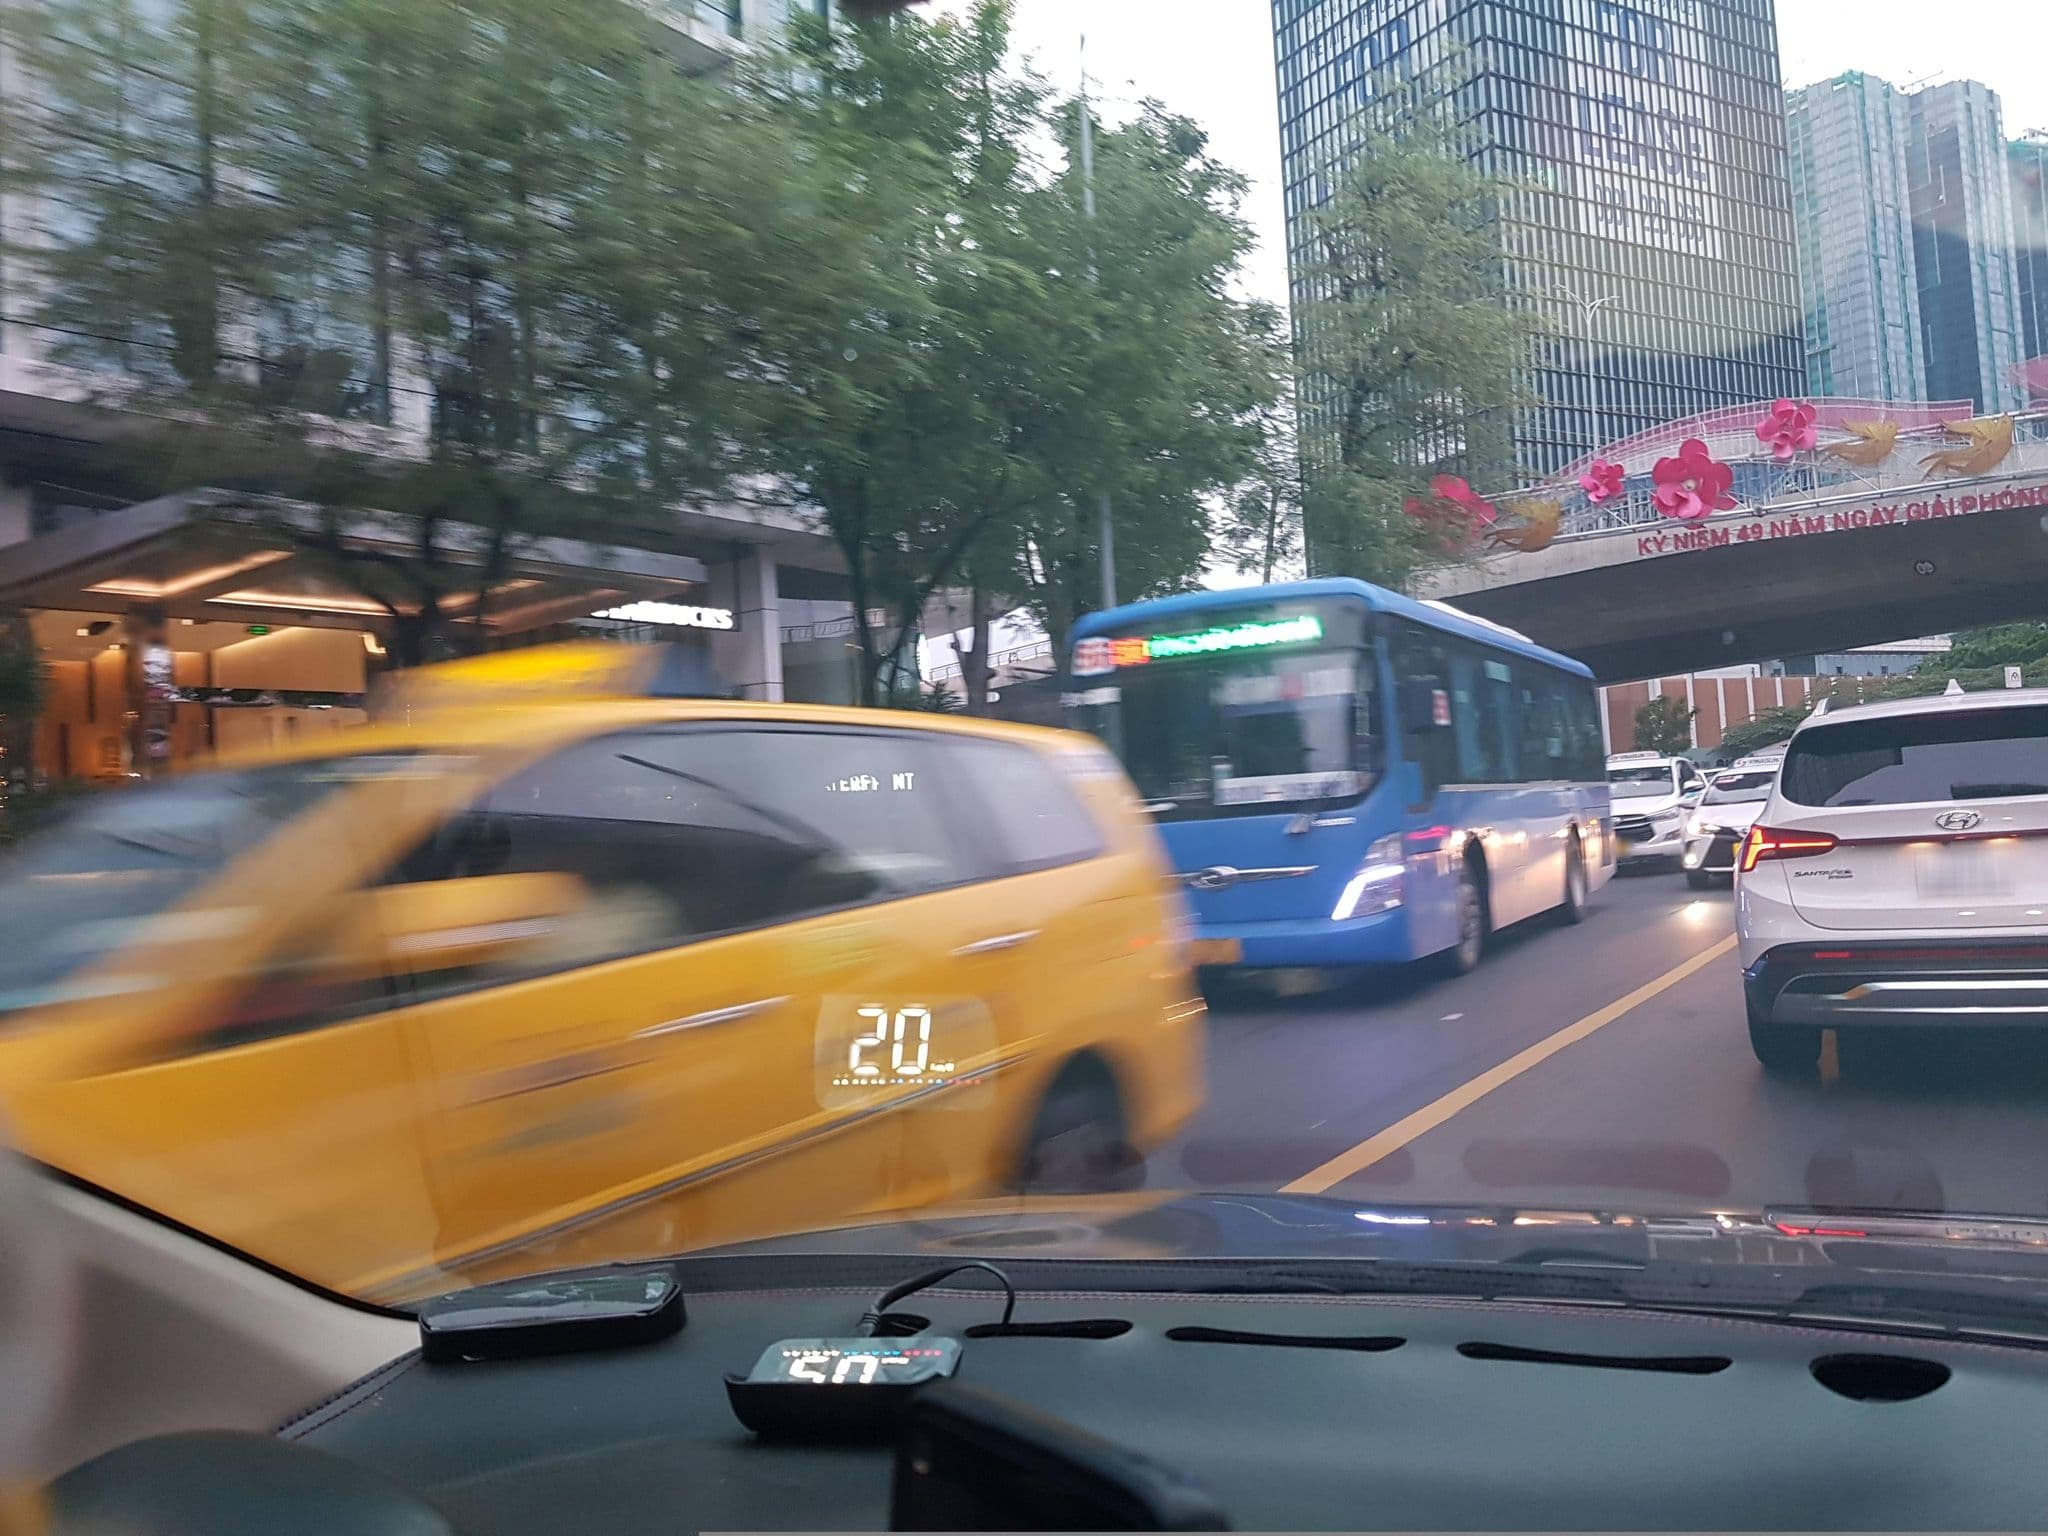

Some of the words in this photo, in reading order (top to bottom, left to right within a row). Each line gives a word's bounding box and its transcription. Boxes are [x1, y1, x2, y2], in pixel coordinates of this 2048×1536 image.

[1596, 3, 1675, 86] FOR
[1577, 87, 1707, 182] LEASE
[1674, 527, 1731, 552] NIỆM
[1736, 523, 1765, 542] 49
[1770, 514, 1826, 539] NĂM
[1833, 503, 1898, 531] NGÀY
[849, 1006, 932, 1076] 20
